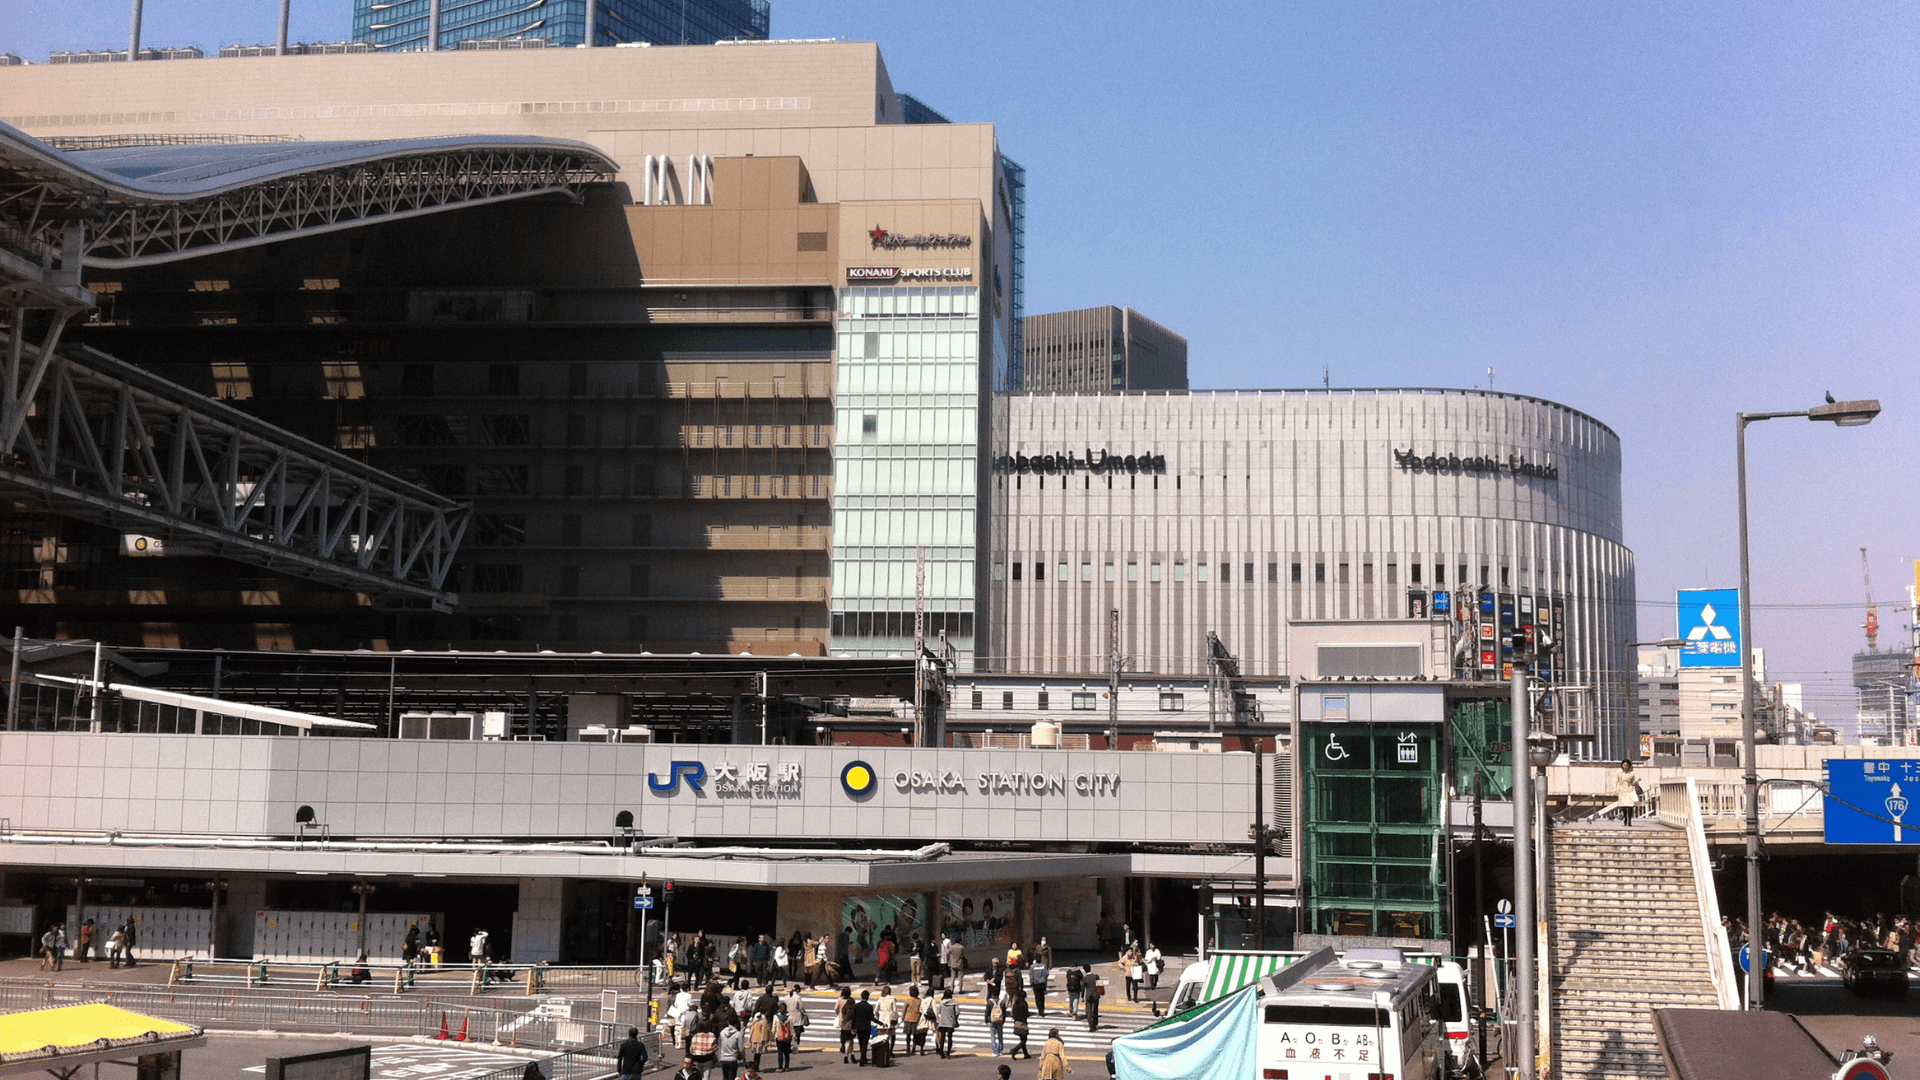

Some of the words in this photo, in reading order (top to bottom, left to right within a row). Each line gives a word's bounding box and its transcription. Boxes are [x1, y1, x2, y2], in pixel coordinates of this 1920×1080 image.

[849, 268, 894, 277] KONAMI
[900, 267, 941, 277] SPORTS
[943, 267, 971, 276] CLUB
[648, 761, 706, 790] JR
[713, 761, 801, 781] 大阪駅
[754, 783, 798, 793] STATION
[893, 770, 966, 788] OSAKA
[977, 772, 1063, 790] STATION
[1074, 773, 1119, 791] CITY
[1889, 800, 1905, 811] 176
[1285, 1047, 1369, 1062] 血液不足
